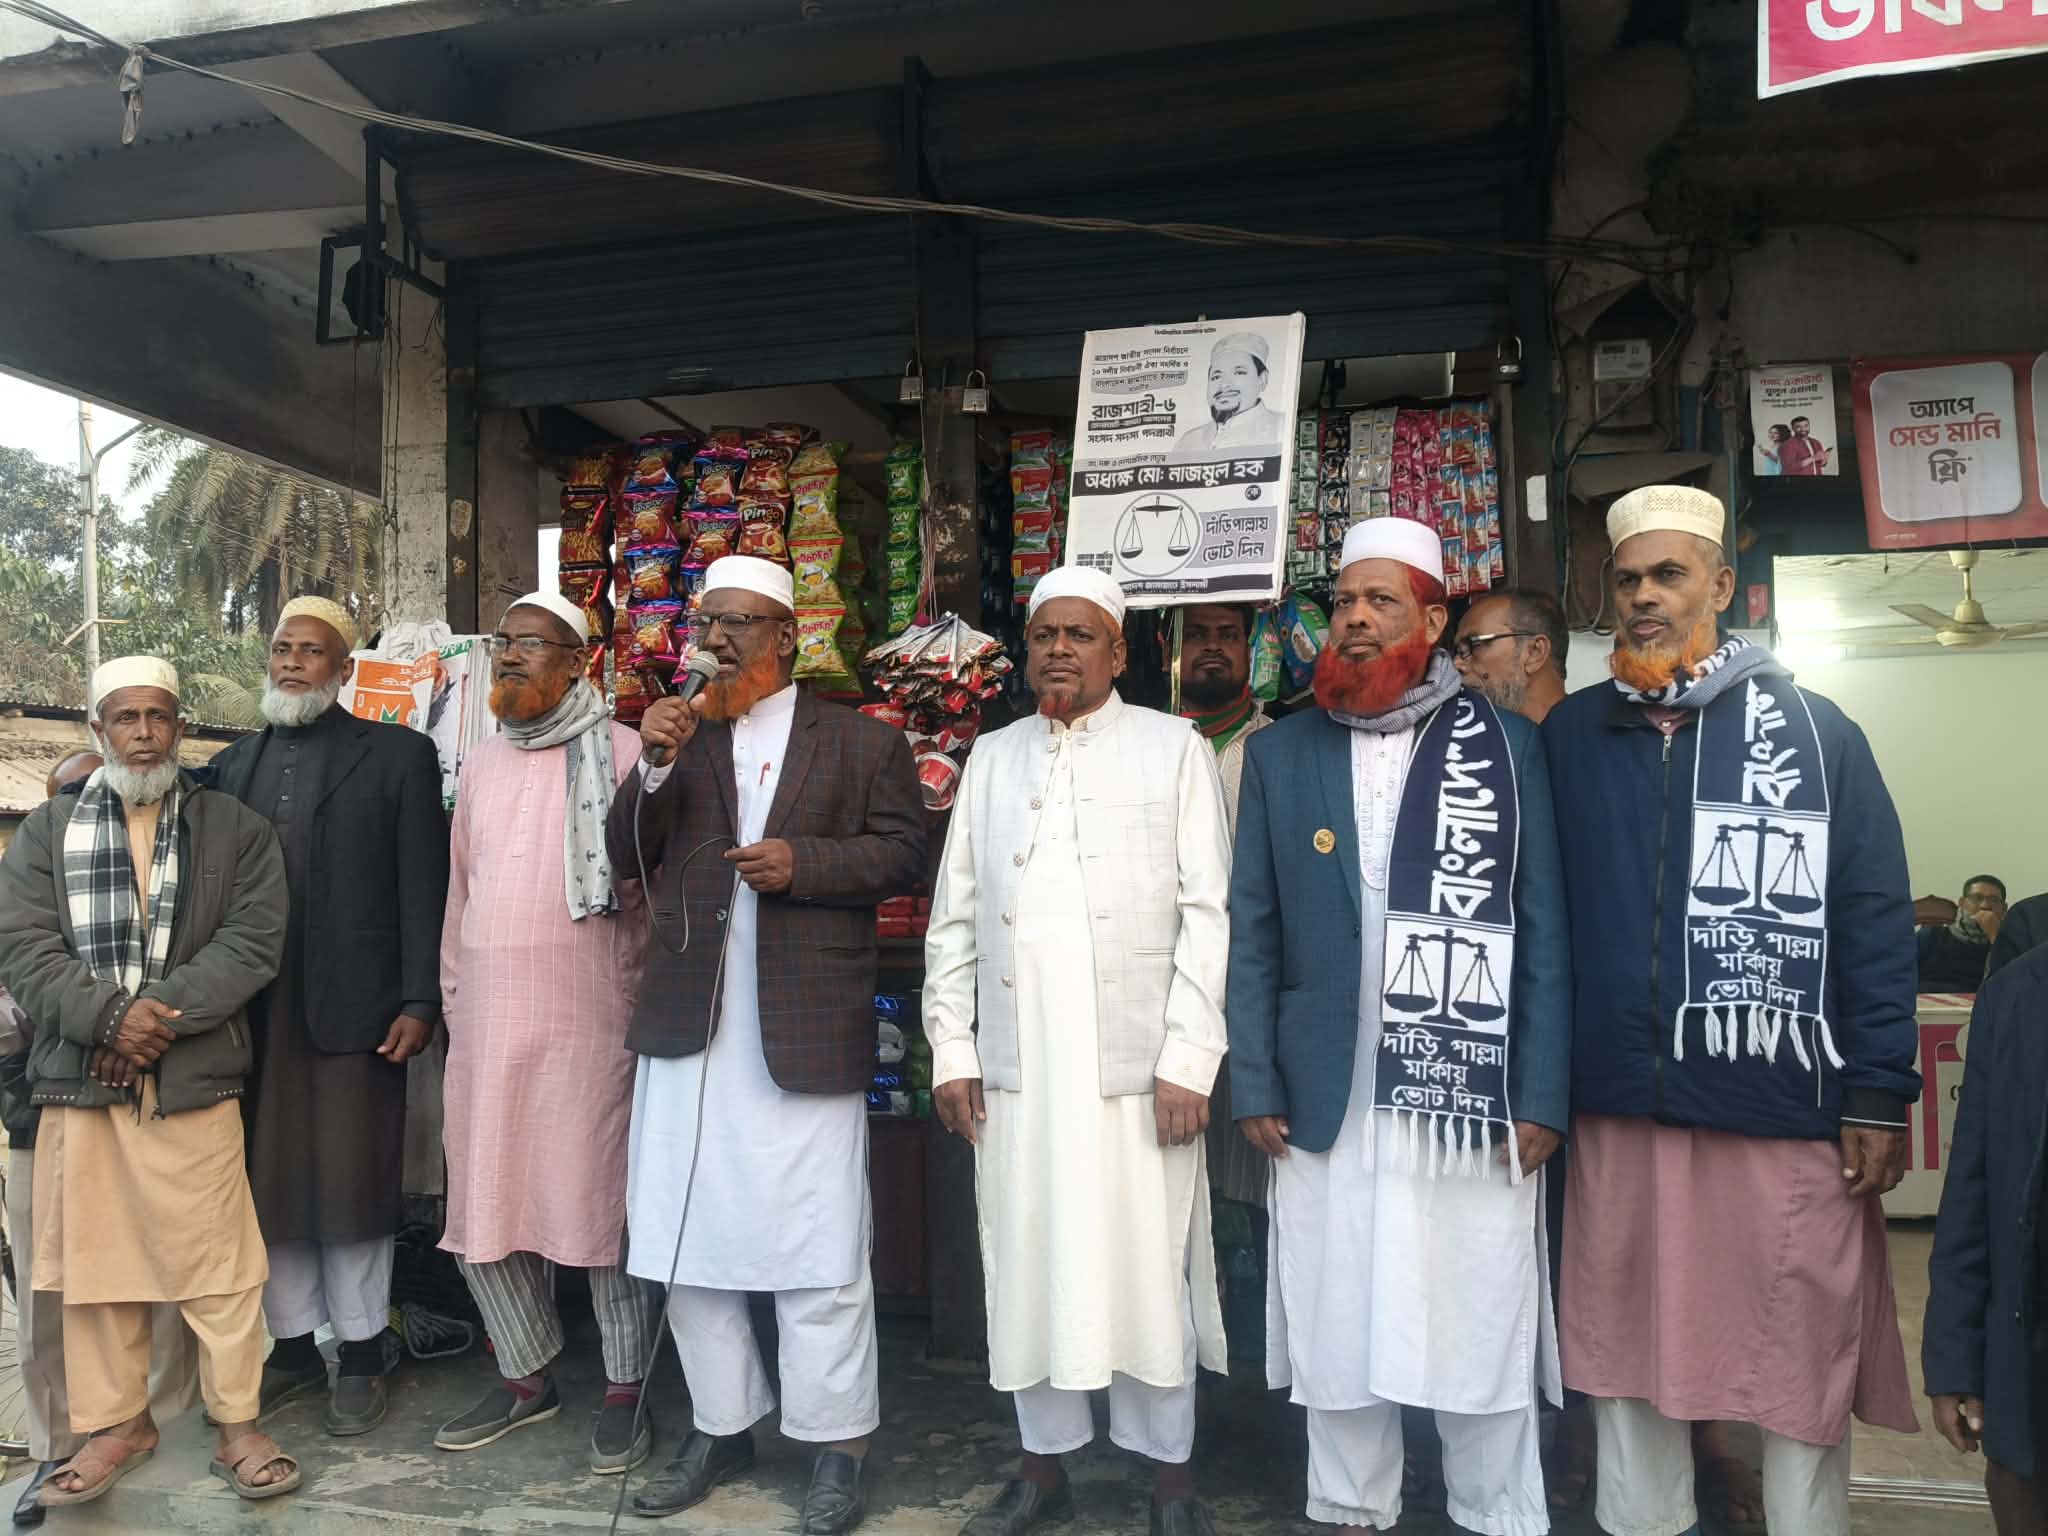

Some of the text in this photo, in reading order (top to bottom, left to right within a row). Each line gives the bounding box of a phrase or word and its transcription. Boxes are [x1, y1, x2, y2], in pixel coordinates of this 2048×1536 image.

[1091, 393, 1176, 420] রাজশাহী-৬
[1907, 396, 1975, 419] অ্যাপে
[1087, 433, 1113, 443] সংসদ
[1888, 411, 2002, 449] সেন্ড মানি
[1084, 458, 1265, 490] অধ্যক্ষ মোঃ নাজমুল হক
[1205, 512, 1270, 538] দাঁড়িপাল্লায়
[1202, 537, 1265, 565] ভোট দিন
[1689, 916, 1823, 960] দাঁড়ি পাল্লা
[1714, 947, 1785, 978] মার্কায়
[1705, 972, 1808, 1012] ভোট দিন
[1383, 1022, 1505, 1067] দাঁড়ি পাল্লা
[1400, 1056, 1469, 1086] মার্কায়
[1391, 1081, 1497, 1117] ভোট দিন
